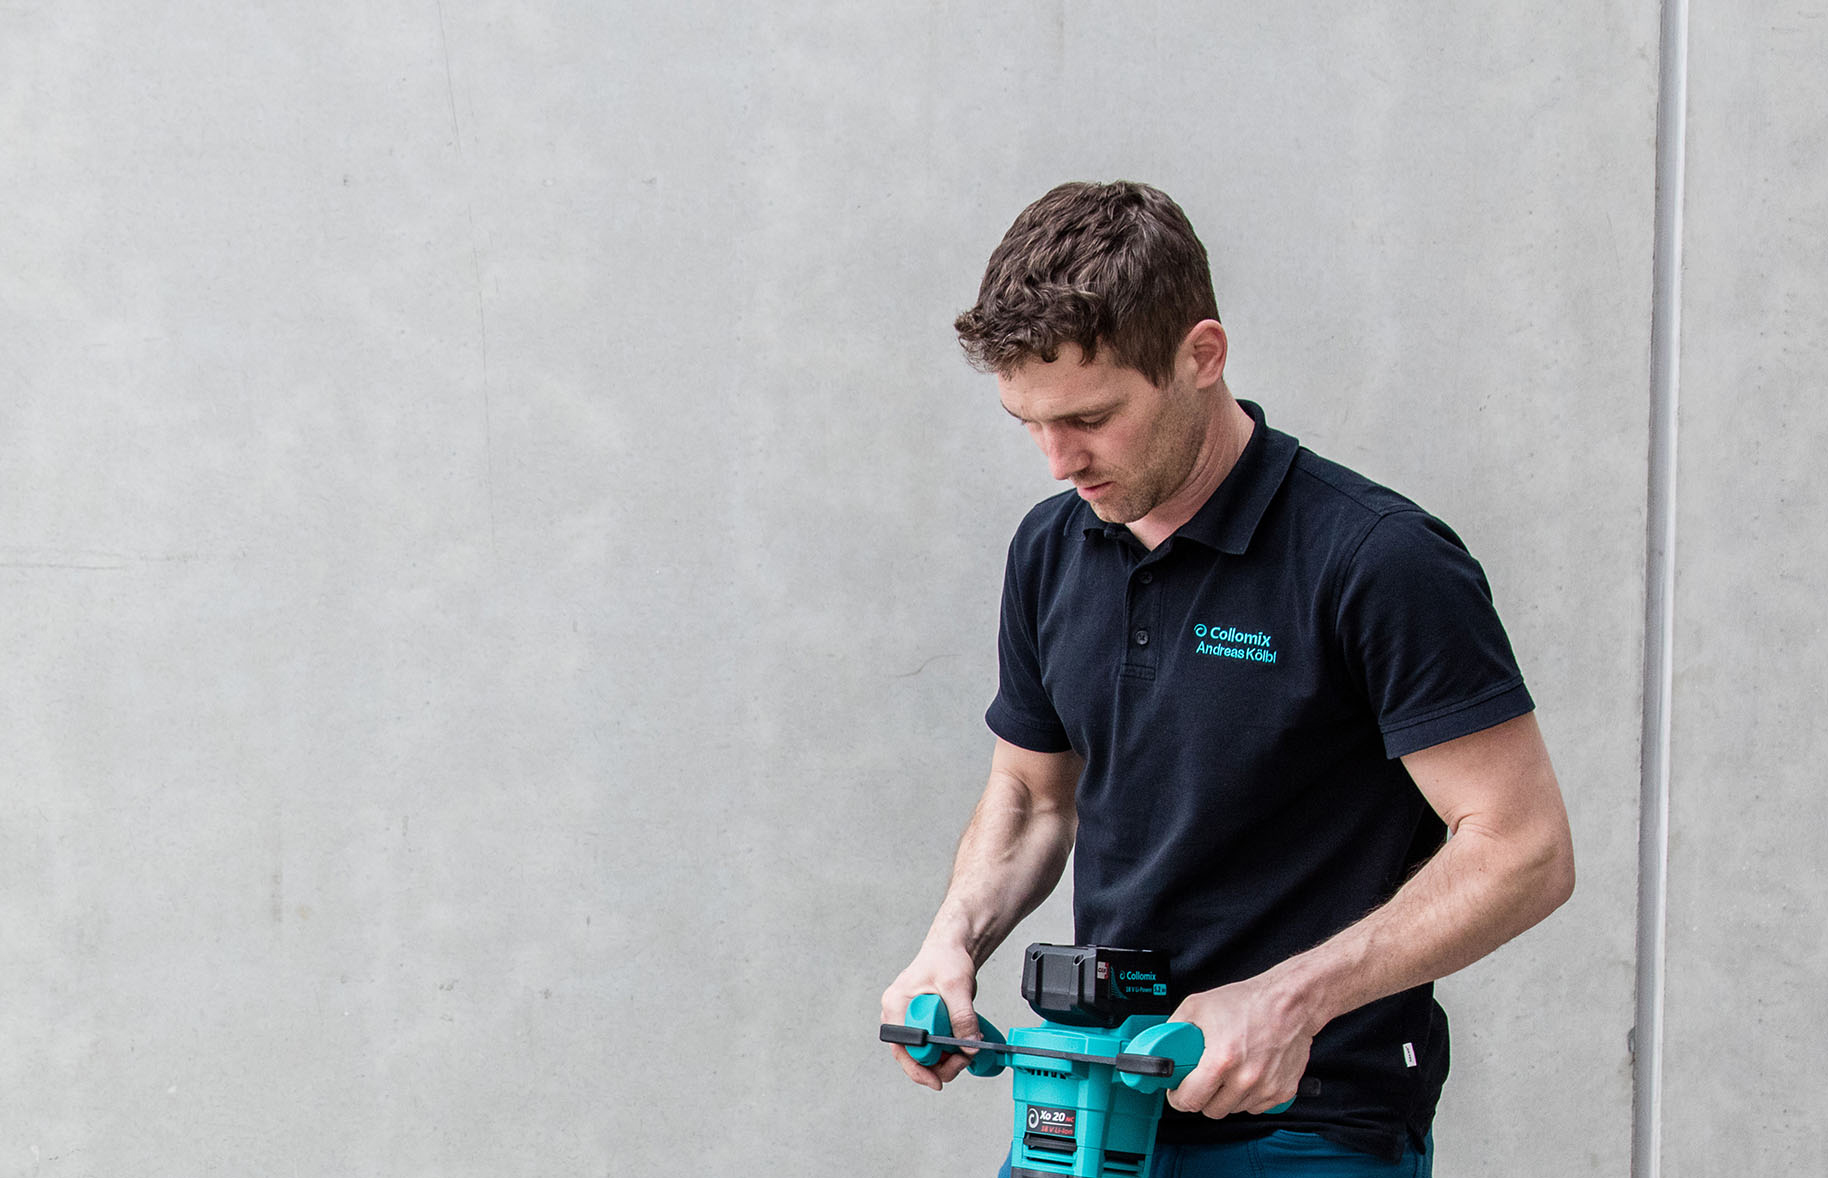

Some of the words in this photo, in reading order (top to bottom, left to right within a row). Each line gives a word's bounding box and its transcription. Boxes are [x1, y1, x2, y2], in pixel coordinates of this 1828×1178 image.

[1210, 626, 1271, 648] Collomix
[1196, 640, 1245, 660] Andreas
[1245, 647, 1277, 664] Kölbl
[1126, 970, 1157, 981] Collomix
[1040, 1110, 1052, 1121] Xo
[1052, 1112, 1066, 1122] 20
